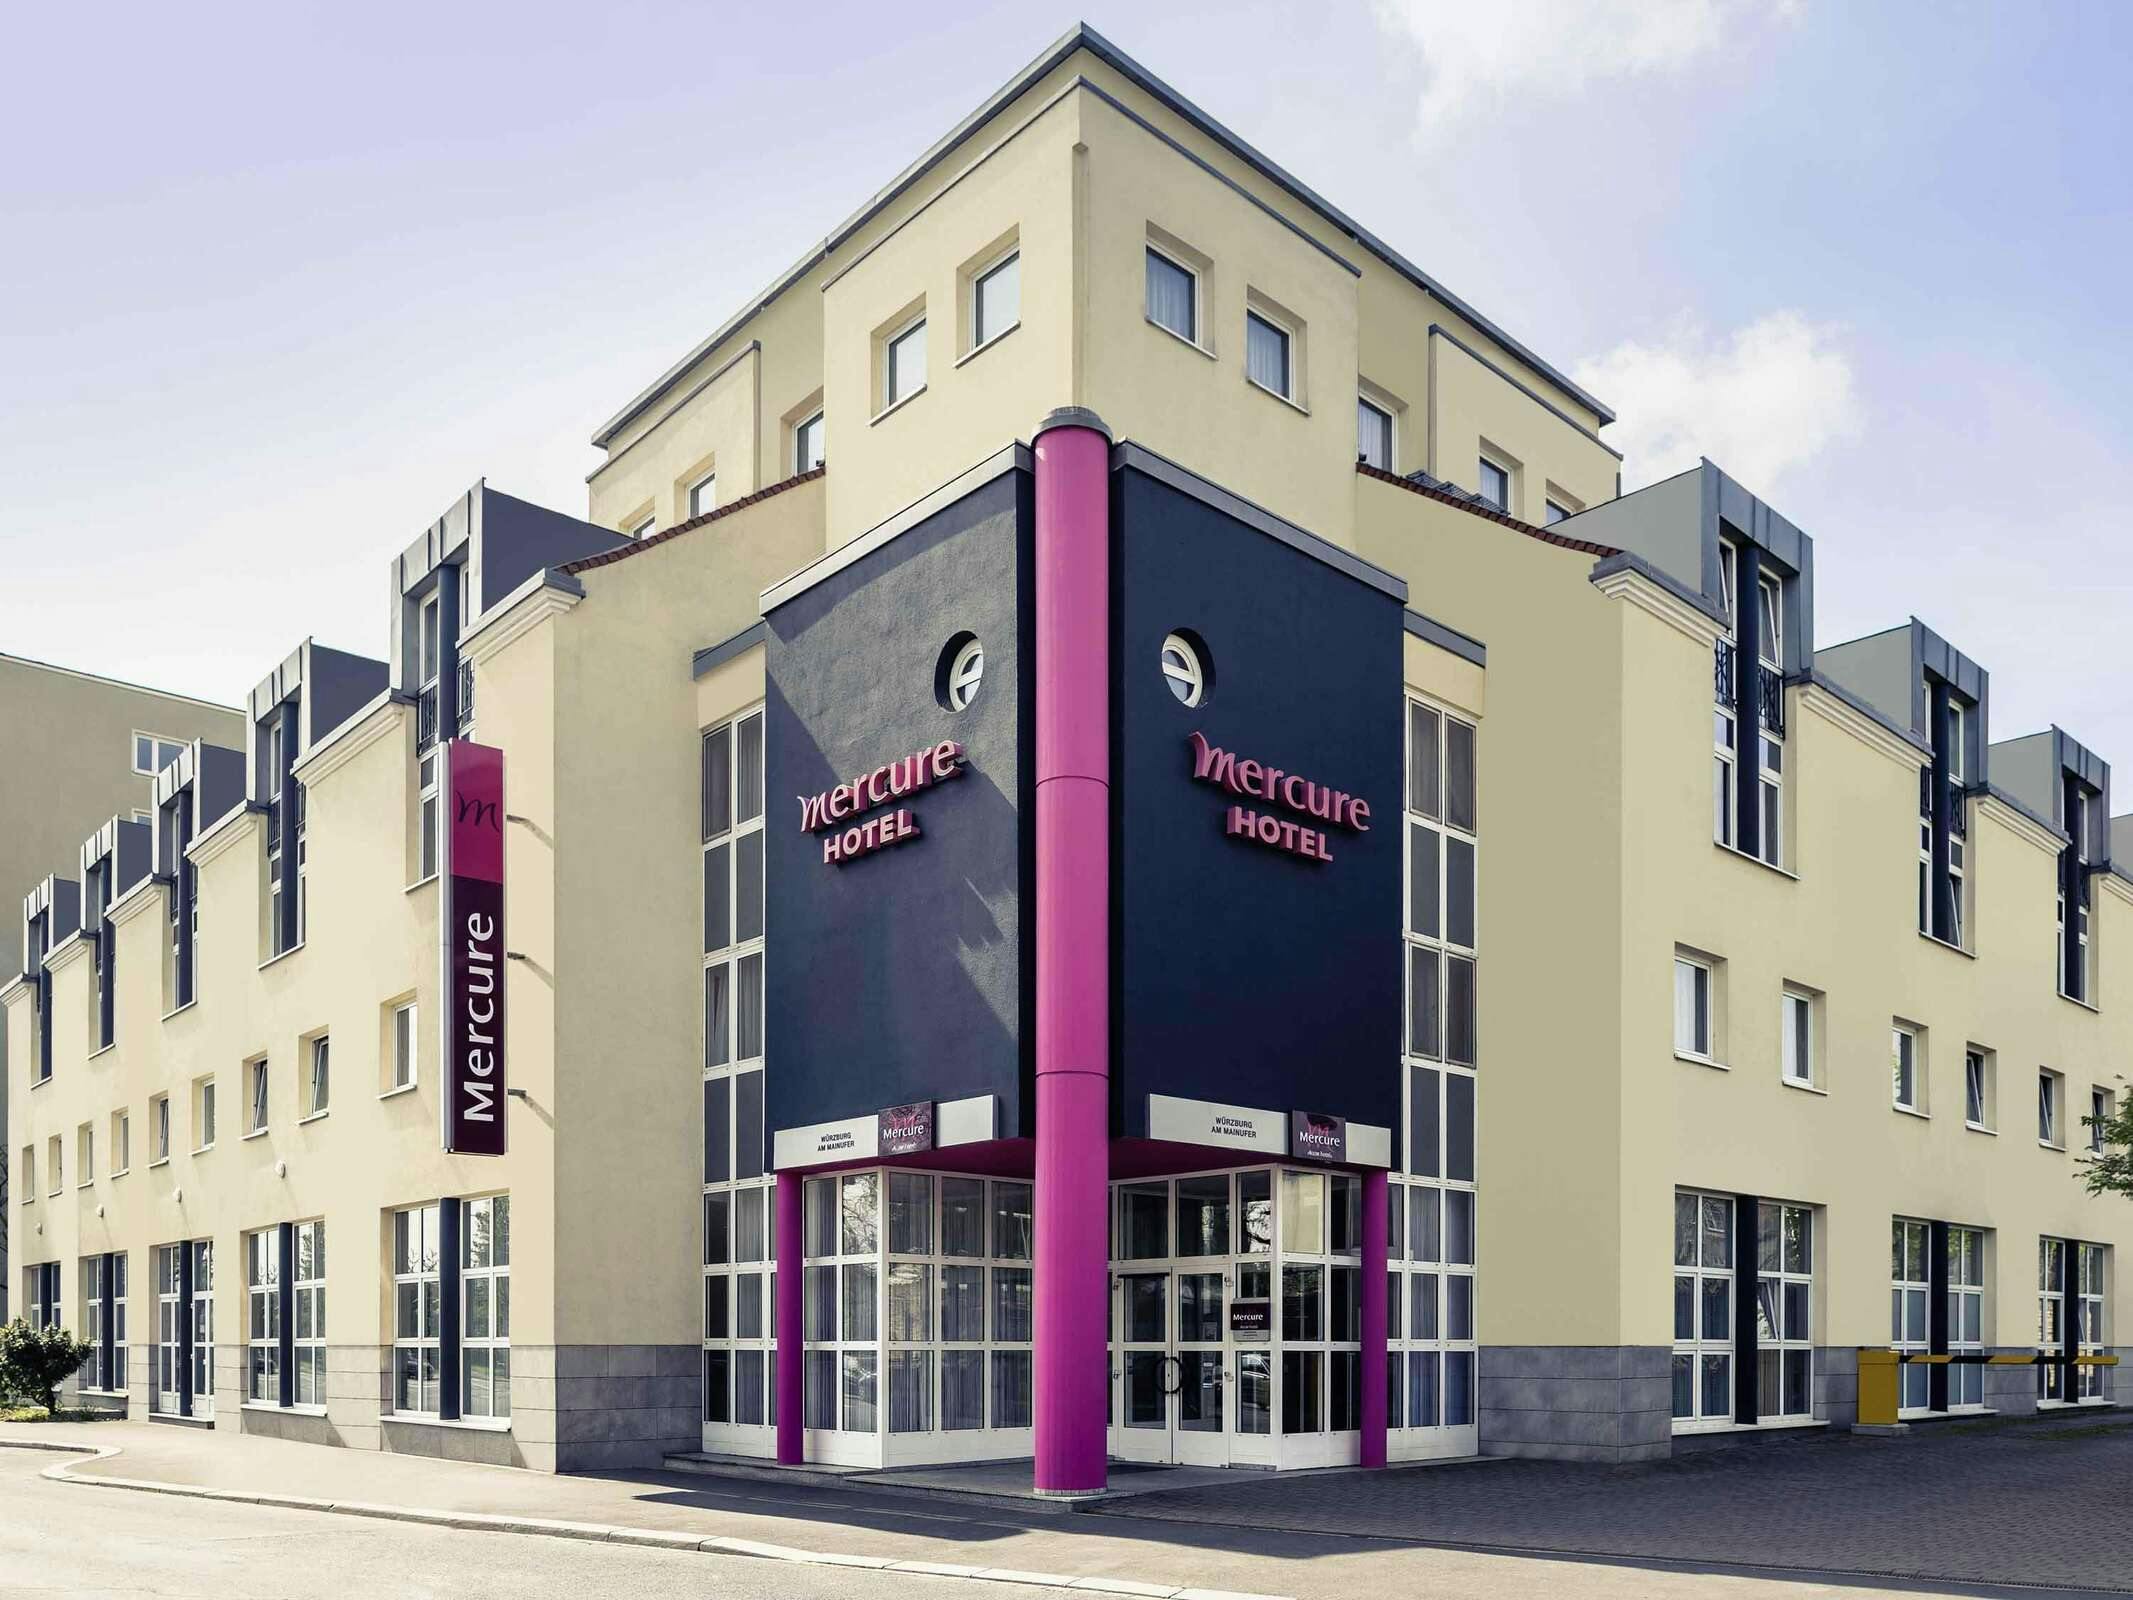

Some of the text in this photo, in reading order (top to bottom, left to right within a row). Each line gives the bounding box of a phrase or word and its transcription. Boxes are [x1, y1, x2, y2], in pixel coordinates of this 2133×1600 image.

[823, 809, 919, 864] HOTEL
[1227, 806, 1334, 862] HOTEL
[463, 912, 494, 1122] Mercure
[1215, 1116, 1253, 1129] WÜRZBURG
[821, 1131, 852, 1143] WÜRZBURG
[883, 1124, 924, 1140] Mercure
[1211, 1126, 1257, 1138] AM MAINUFER
[1299, 1131, 1341, 1147] Mercure
[817, 1140, 855, 1152] AM MAINUFER
[1232, 1313, 1264, 1321] Mercure
